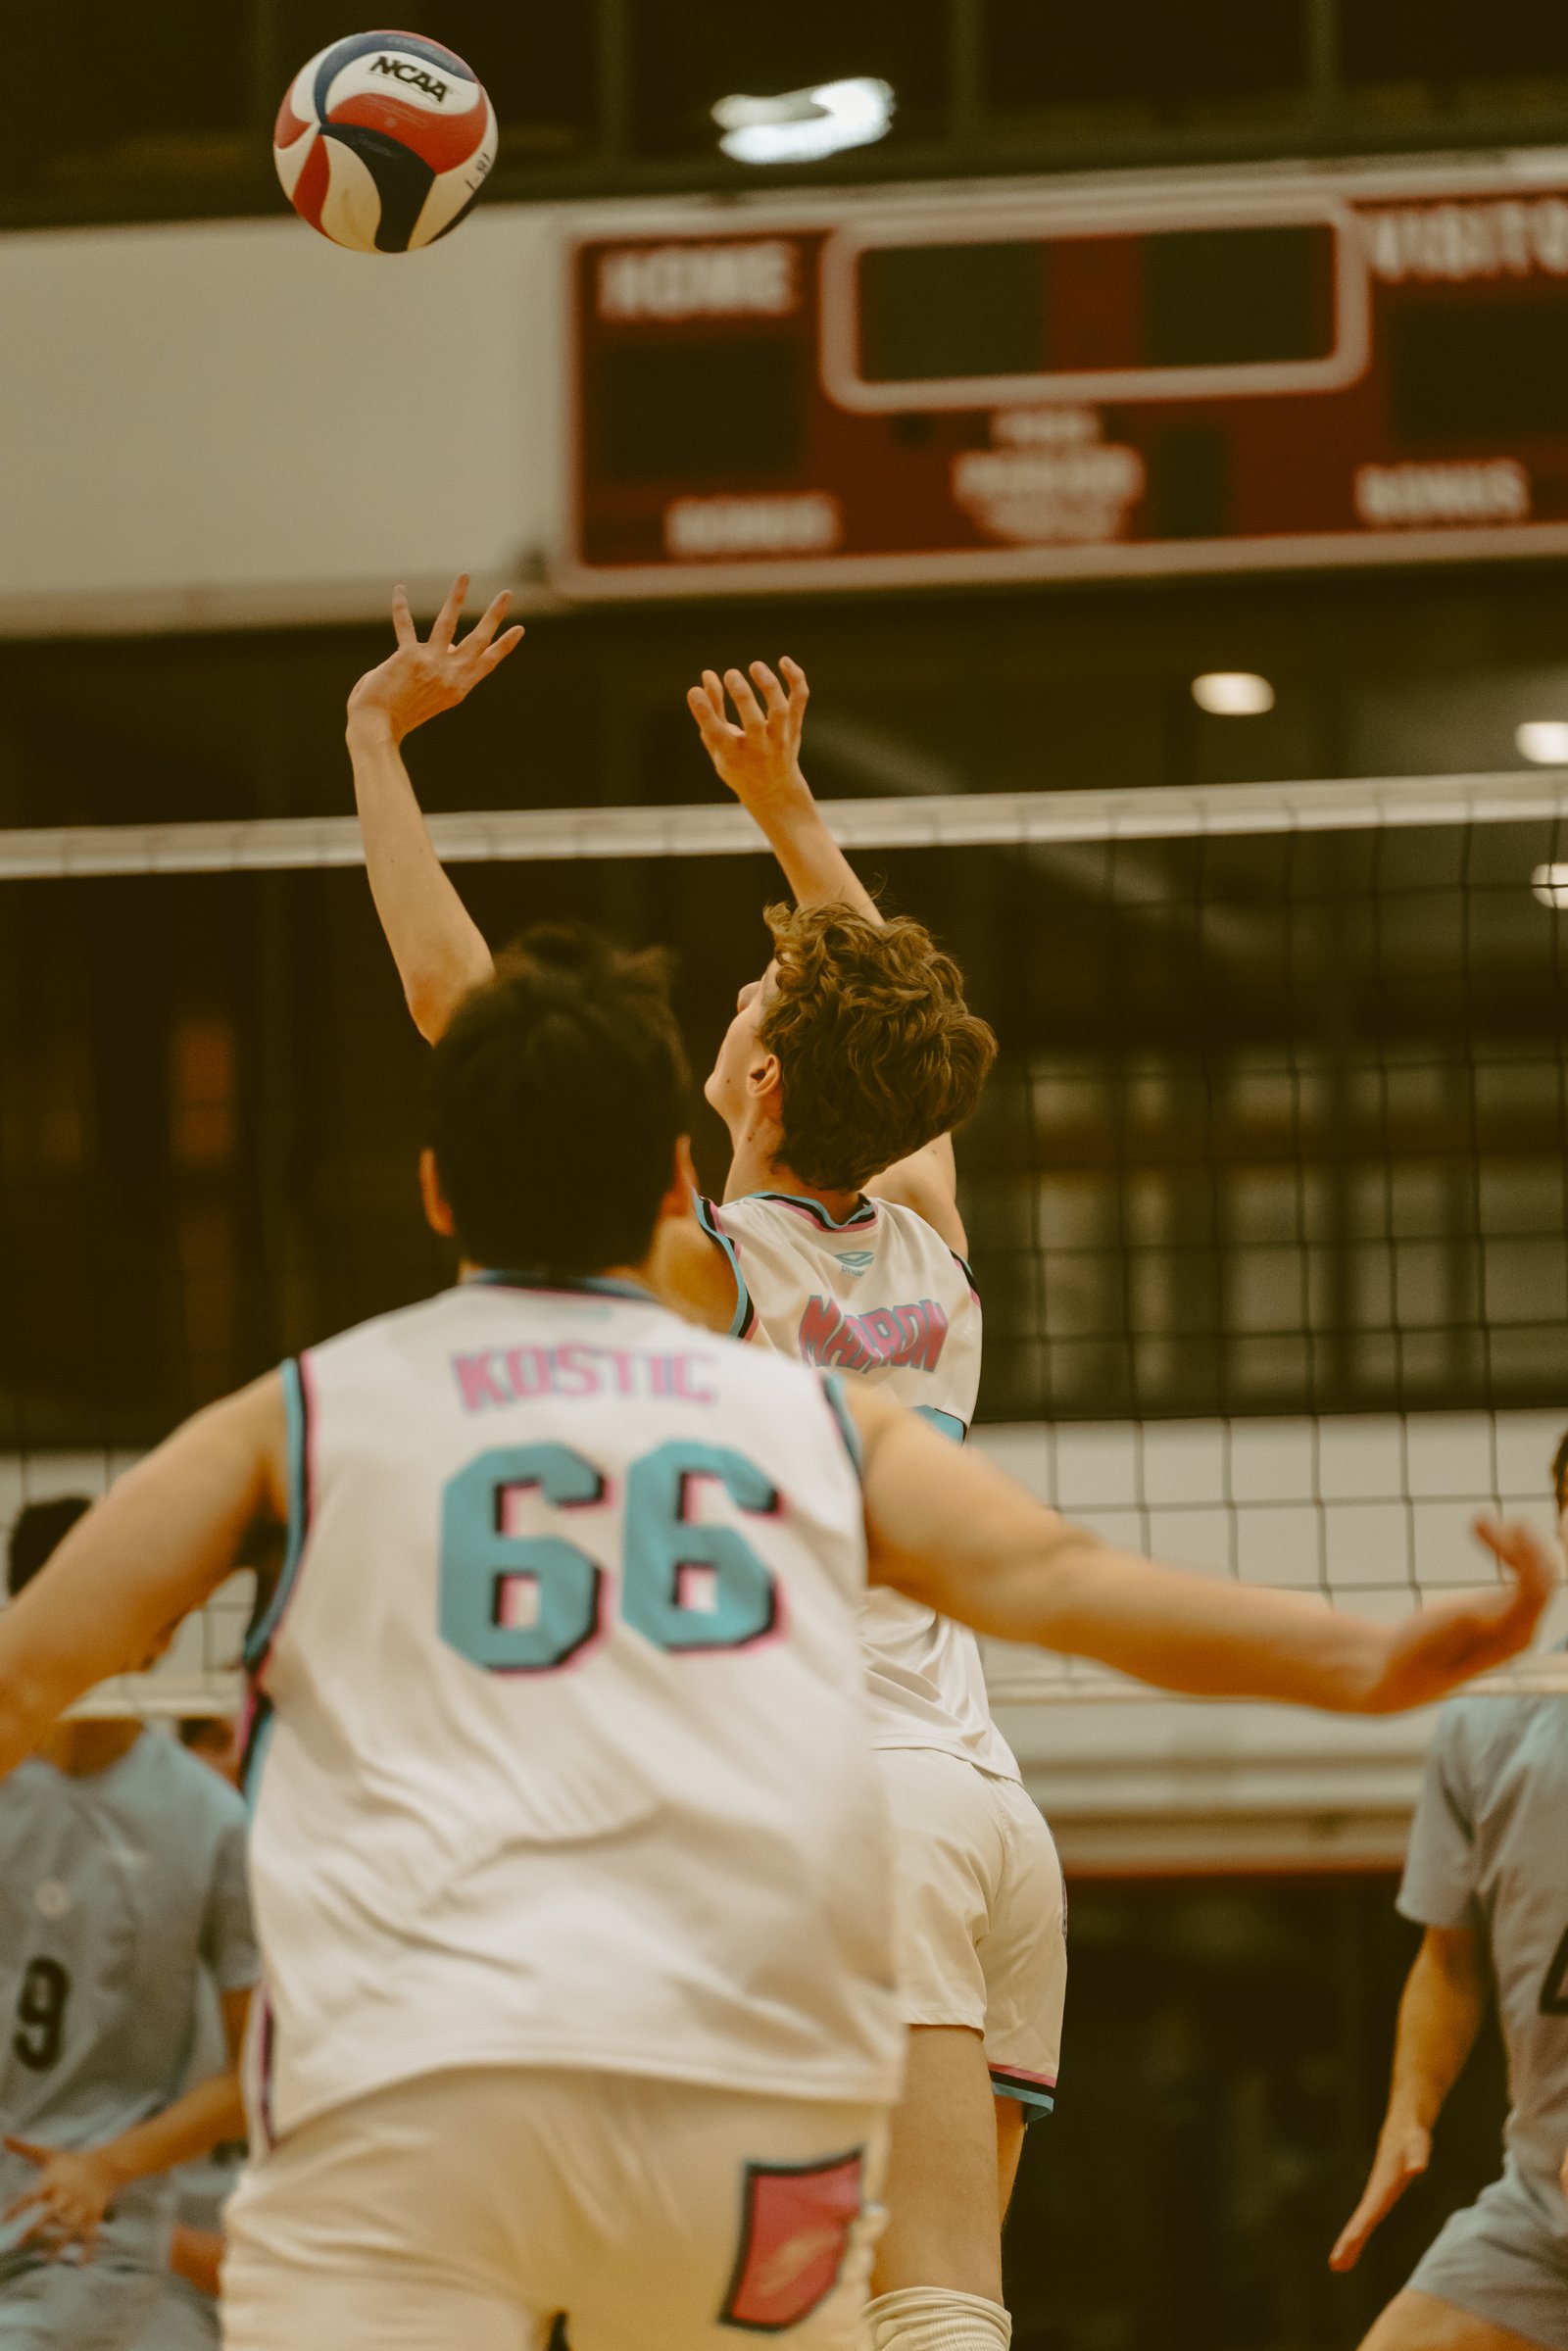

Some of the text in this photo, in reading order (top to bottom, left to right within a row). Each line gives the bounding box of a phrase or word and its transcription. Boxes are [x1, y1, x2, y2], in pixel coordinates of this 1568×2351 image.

[368, 55, 451, 103] NCAA
[452, 1343, 718, 1414] KOSTIC
[440, 1439, 786, 1677] 66
[15, 1956, 70, 2071] 9
